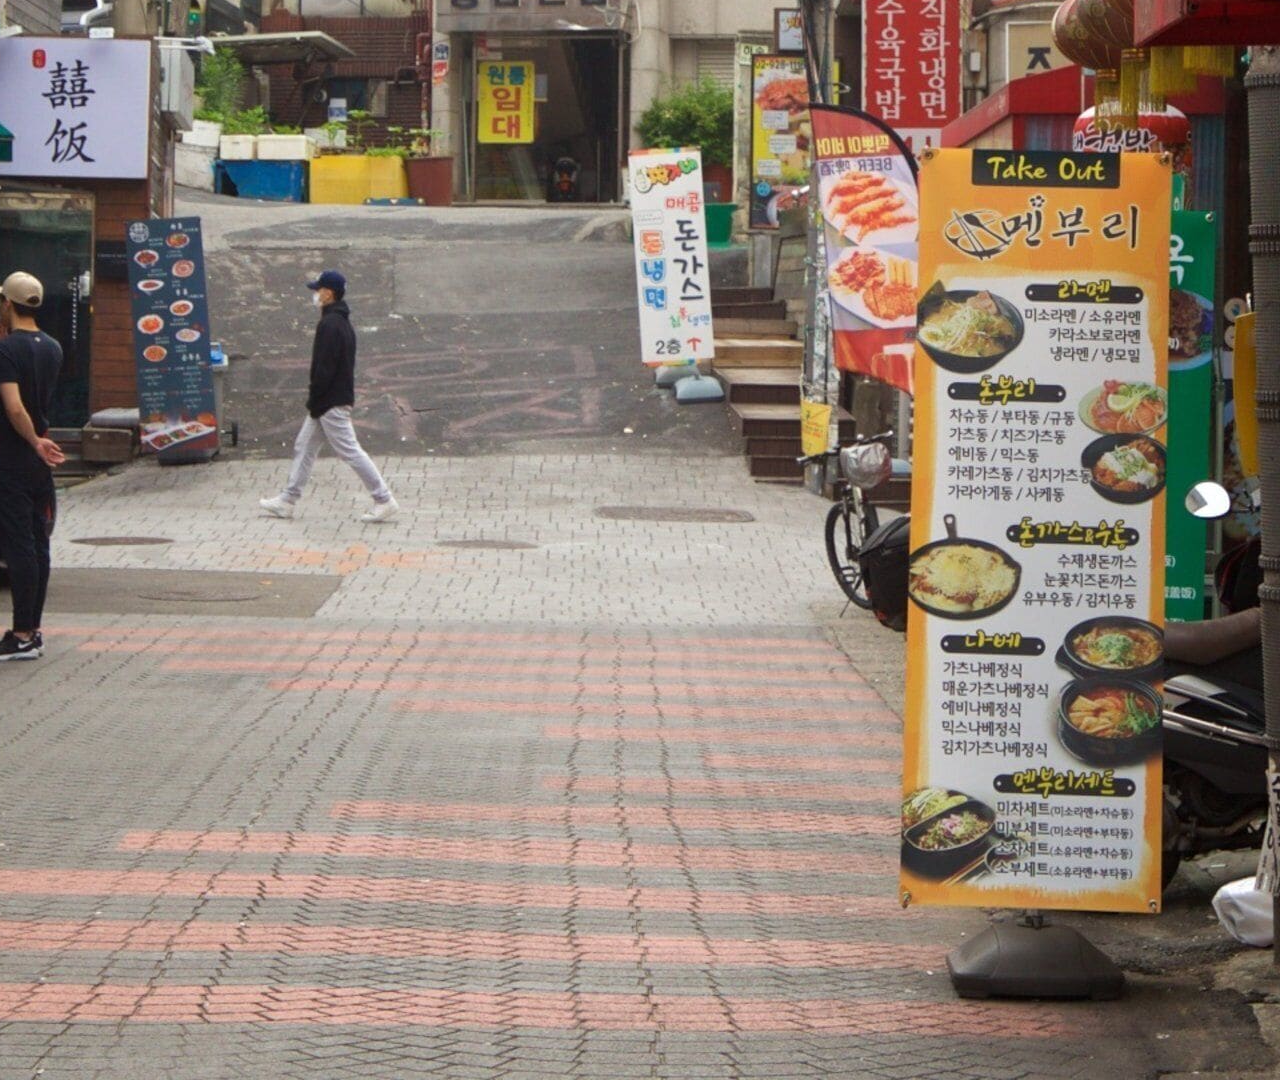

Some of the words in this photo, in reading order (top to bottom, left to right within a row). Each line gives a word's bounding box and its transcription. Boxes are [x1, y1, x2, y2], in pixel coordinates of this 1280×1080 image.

[487, 65, 526, 86] 원룸
[492, 86, 522, 139] 임대
[987, 156, 1047, 180] Take
[1059, 157, 1106, 181] Out
[673, 219, 705, 301] 돈가스
[1025, 308, 1076, 326] 미소라멘
[1089, 311, 1141, 327] 소유라멘
[1049, 327, 1141, 345] 카라소보로라멘
[654, 338, 682, 356] 2층
[1050, 346, 1089, 363] 냉라멘
[1101, 347, 1141, 364] 냉모밀
[979, 374, 1036, 406] 돈부리
[949, 407, 989, 425] 차슈동
[1001, 409, 1040, 426] 부타동
[948, 427, 989, 445] 가츠동
[1000, 428, 1067, 446] 치즈가츠동
[947, 446, 989, 463] 에비동
[1000, 447, 1040, 464] 믹스동
[947, 465, 1014, 482] 카레가츠동
[1026, 466, 1093, 485] 김치가츠동
[947, 484, 1014, 503] 가라아게동
[1024, 485, 1065, 504] 사케동
[1056, 553, 1138, 571] 수제생돈까스
[1043, 571, 1138, 590] 눈꽃치즈돈까스
[1022, 591, 1074, 609] 유부우동
[1085, 591, 1138, 610] 김치우동
[964, 628, 1022, 649] 나베
[942, 661, 1024, 679] 가츠나베정식
[941, 680, 1050, 699] 매운가츠나베정식
[941, 700, 1022, 718] 에비나베정식
[940, 719, 1022, 738] 믹스나베정식
[941, 739, 1049, 758] 김치가츠나베정식
[1012, 766, 1116, 799] 멘부리세트
